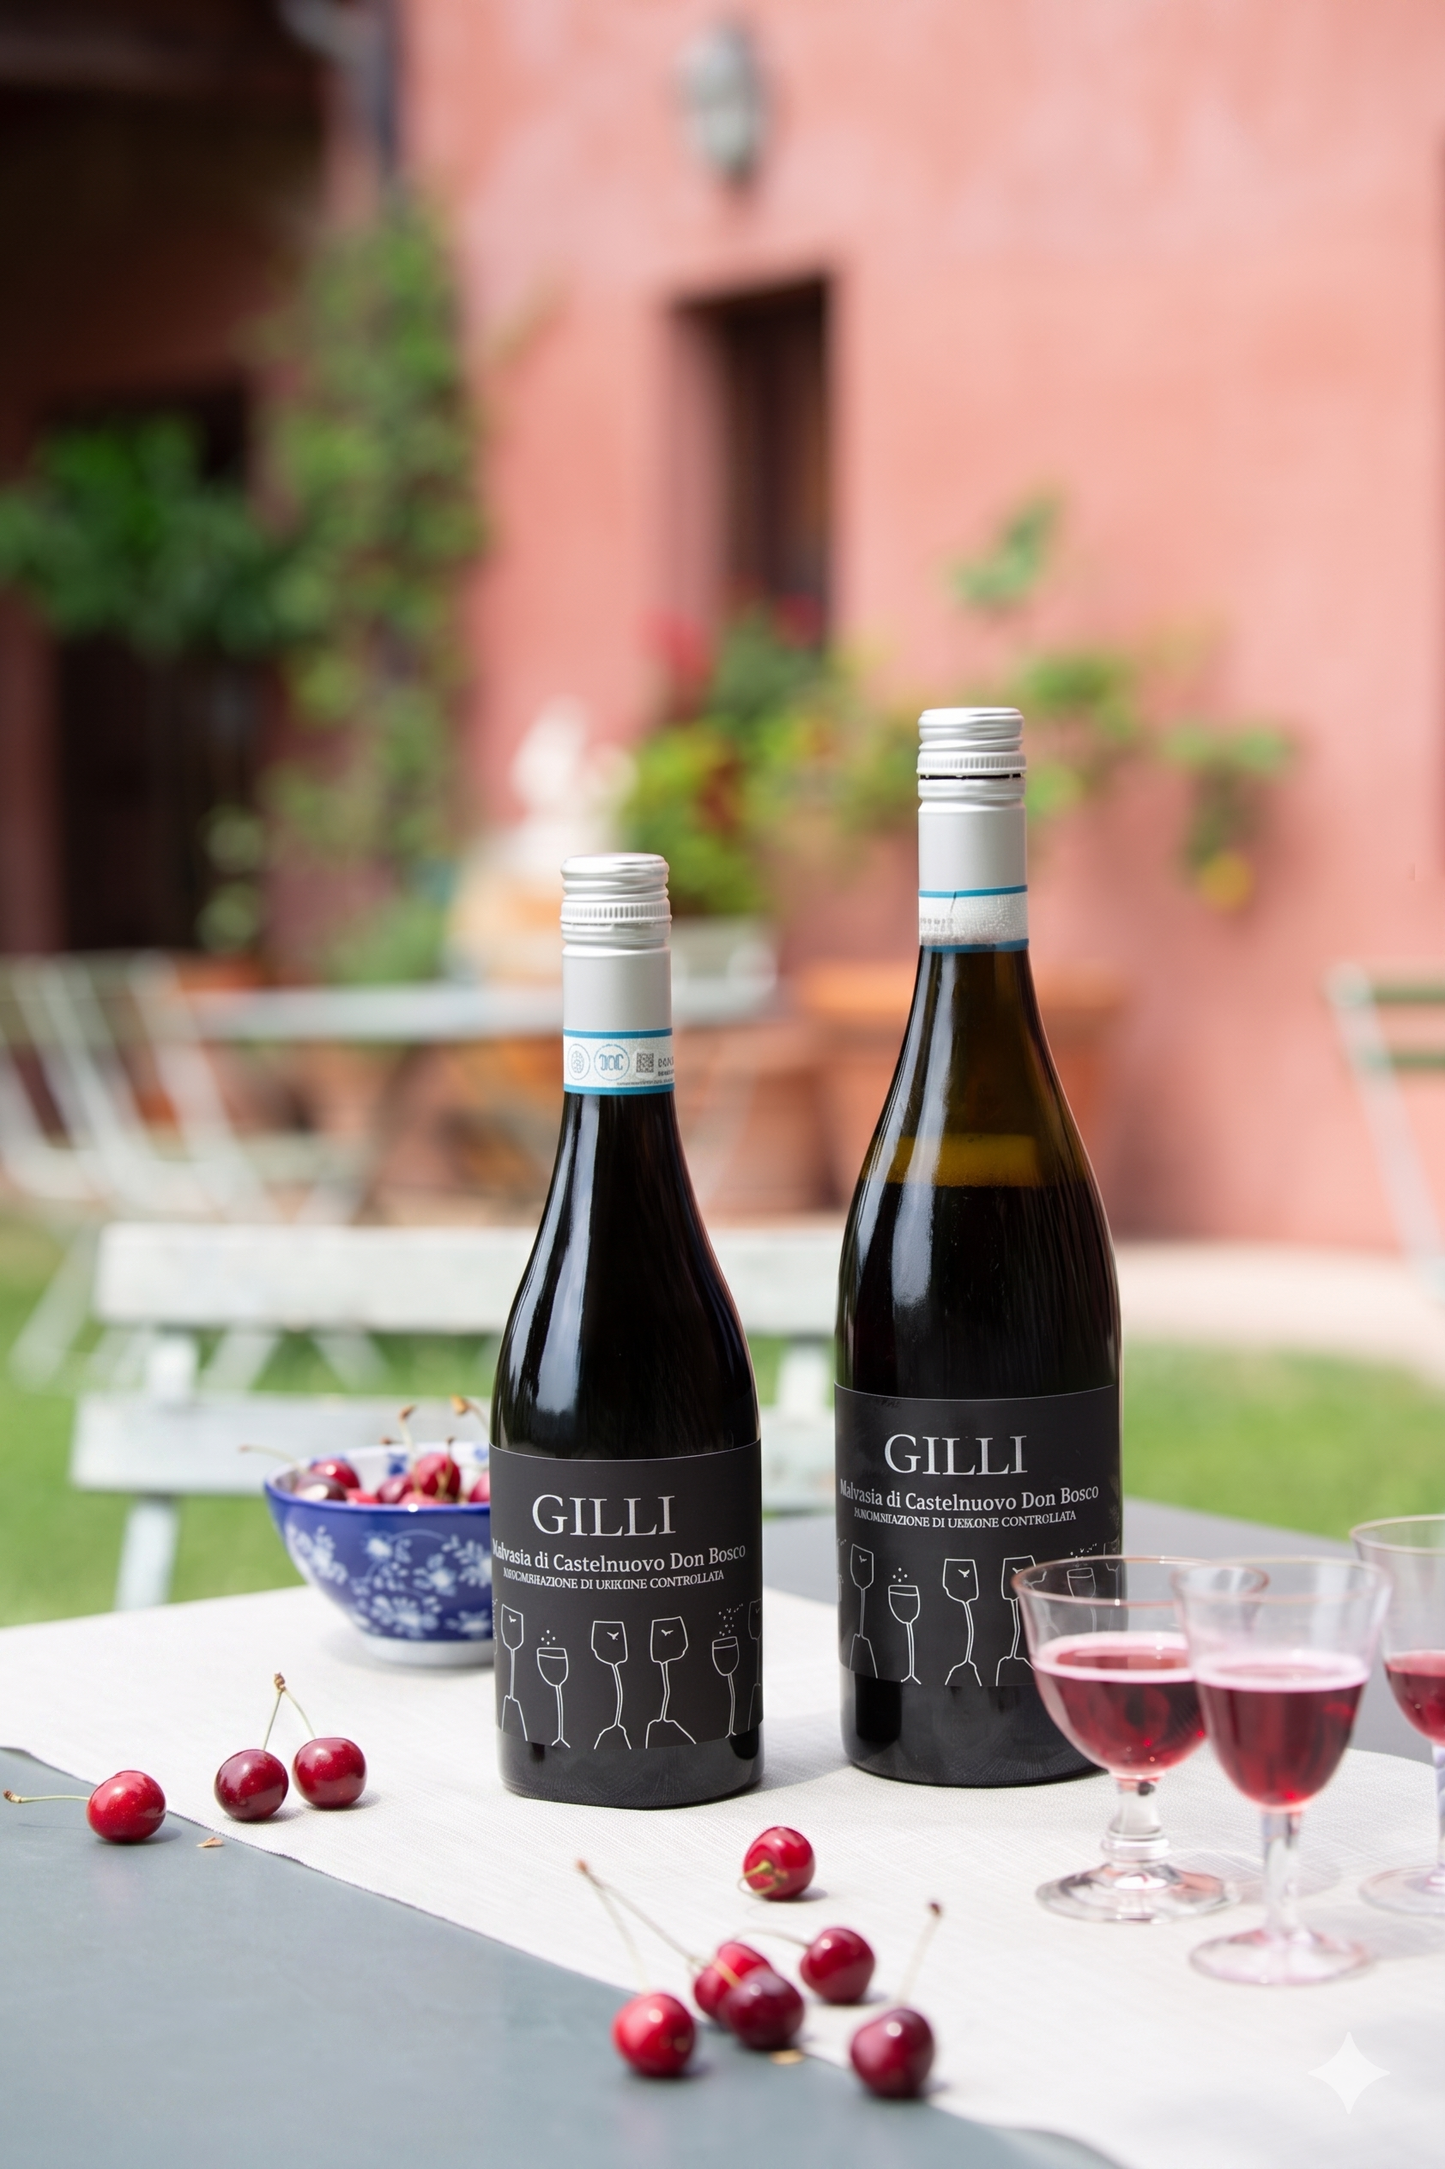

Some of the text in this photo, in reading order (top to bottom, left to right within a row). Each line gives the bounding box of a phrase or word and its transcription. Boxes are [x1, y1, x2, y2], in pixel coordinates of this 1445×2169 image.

[884, 1433, 1028, 1476] GILLI
[886, 1490, 902, 1508] di
[905, 1492, 1017, 1512] Castelnuovo
[1021, 1491, 1056, 1509] Don
[1060, 1485, 1099, 1505] Bosco
[532, 1493, 677, 1537] GILLI
[932, 1517, 946, 1528] DI
[1001, 1510, 1077, 1527] CONTROLLATA
[534, 1551, 550, 1569] di
[553, 1554, 665, 1573] Castelnuovo
[670, 1552, 705, 1570] Don
[708, 1544, 746, 1565] Bosco
[580, 1579, 593, 1590] DI
[649, 1569, 725, 1589] CONTROLLATA
